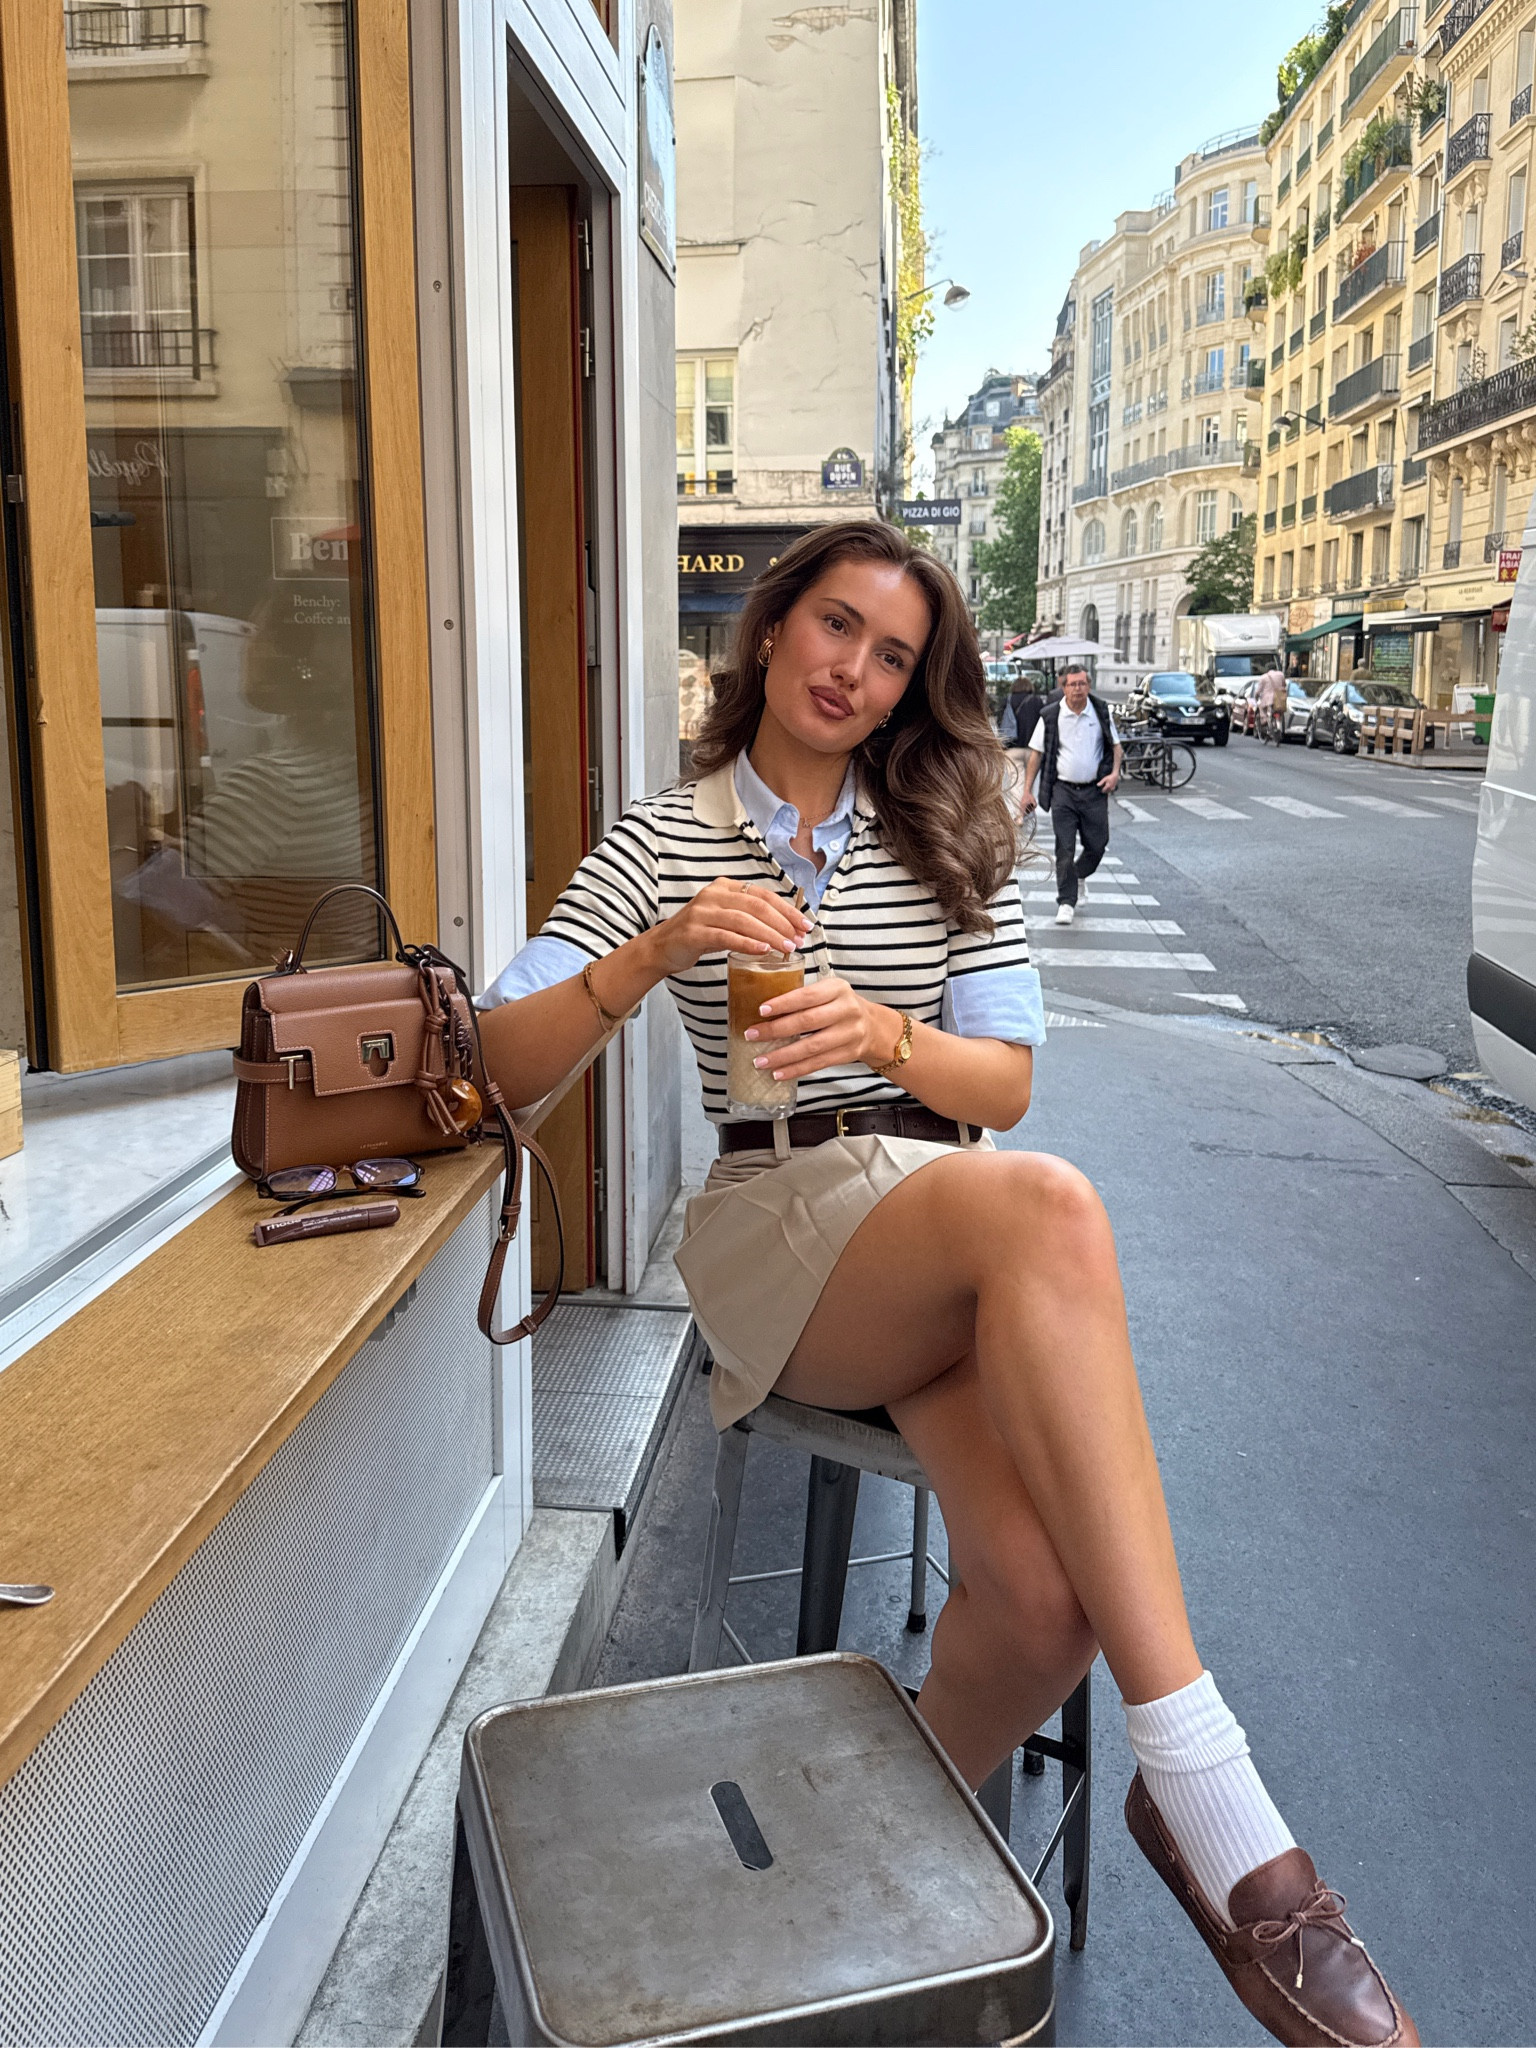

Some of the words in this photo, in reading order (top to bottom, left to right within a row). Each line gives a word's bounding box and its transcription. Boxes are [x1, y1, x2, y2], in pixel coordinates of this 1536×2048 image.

[834, 463, 852, 472] RUE
[829, 472, 857, 481] DUPIN
[902, 507, 930, 518] PIZZA
[931, 507, 941, 517] DI
[942, 506, 960, 517] GIO
[293, 595, 340, 611] Benchy:
[294, 612, 333, 624] Coffee
